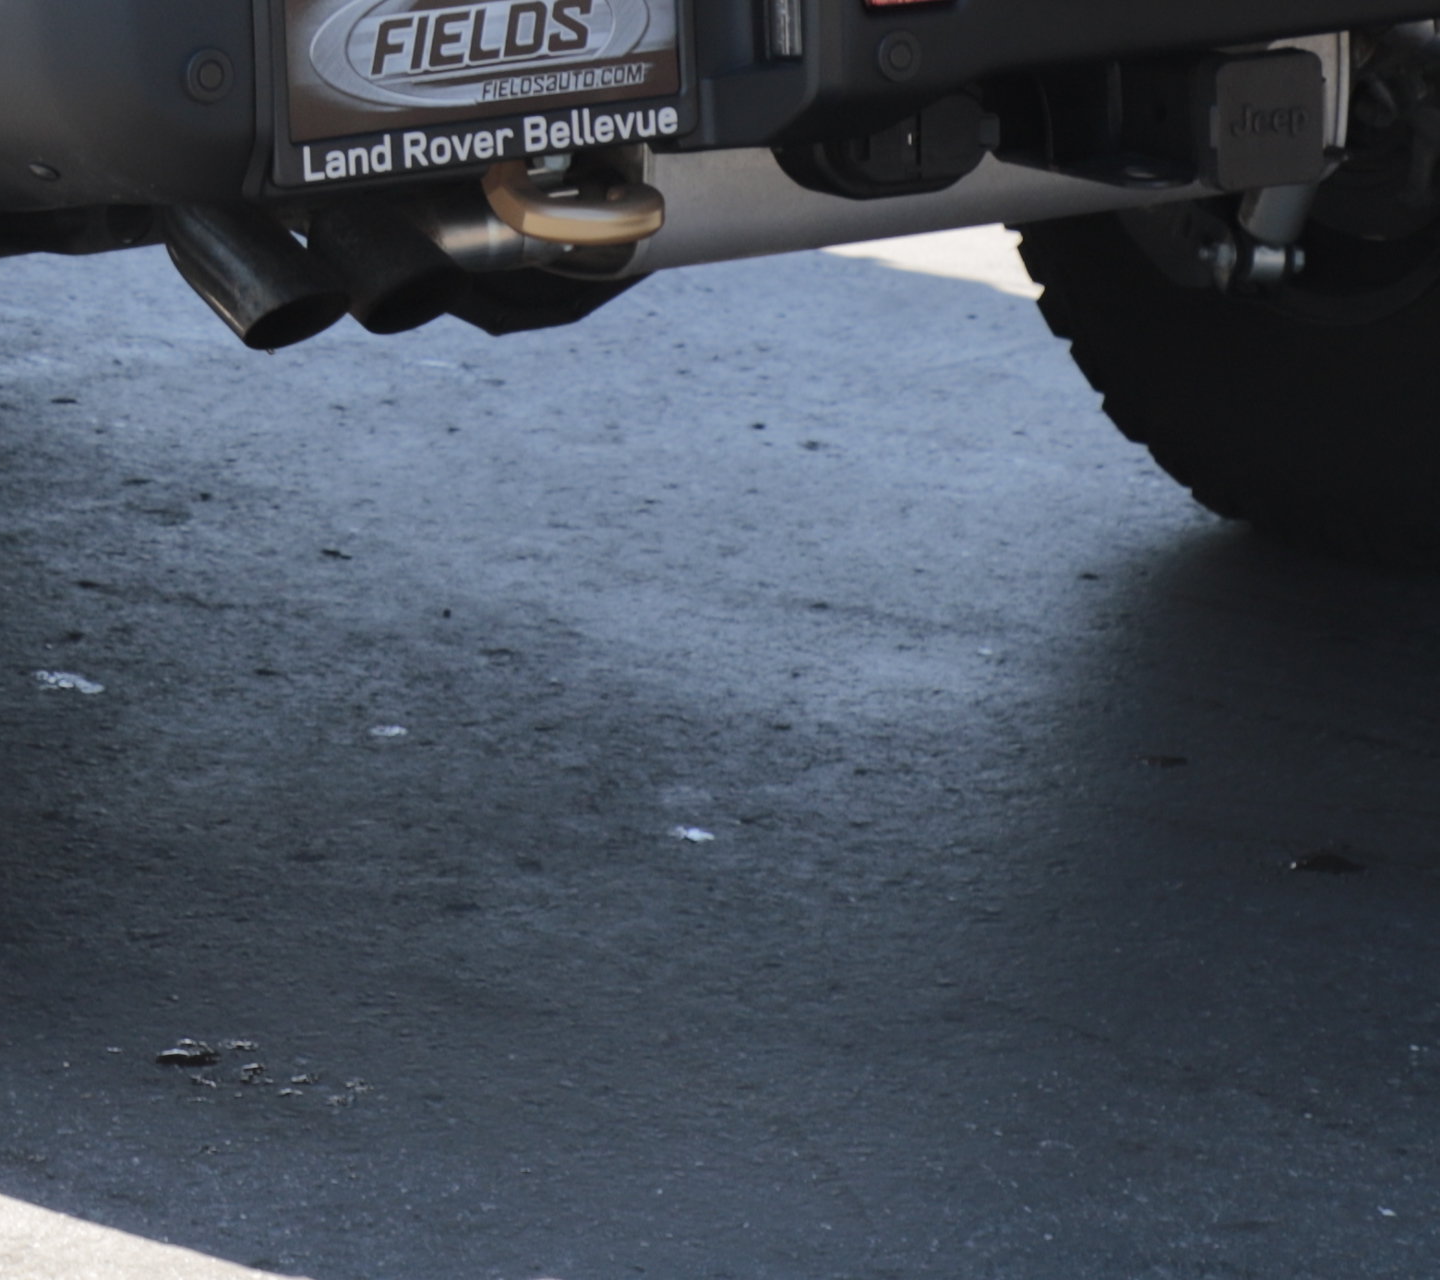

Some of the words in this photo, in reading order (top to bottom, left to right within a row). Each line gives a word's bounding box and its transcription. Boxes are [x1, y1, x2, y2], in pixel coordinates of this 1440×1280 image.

[302, 133, 393, 183] Land
[404, 122, 514, 168] Rover
[522, 105, 679, 153] Bellevue
[1228, 101, 1310, 138] Jeep
